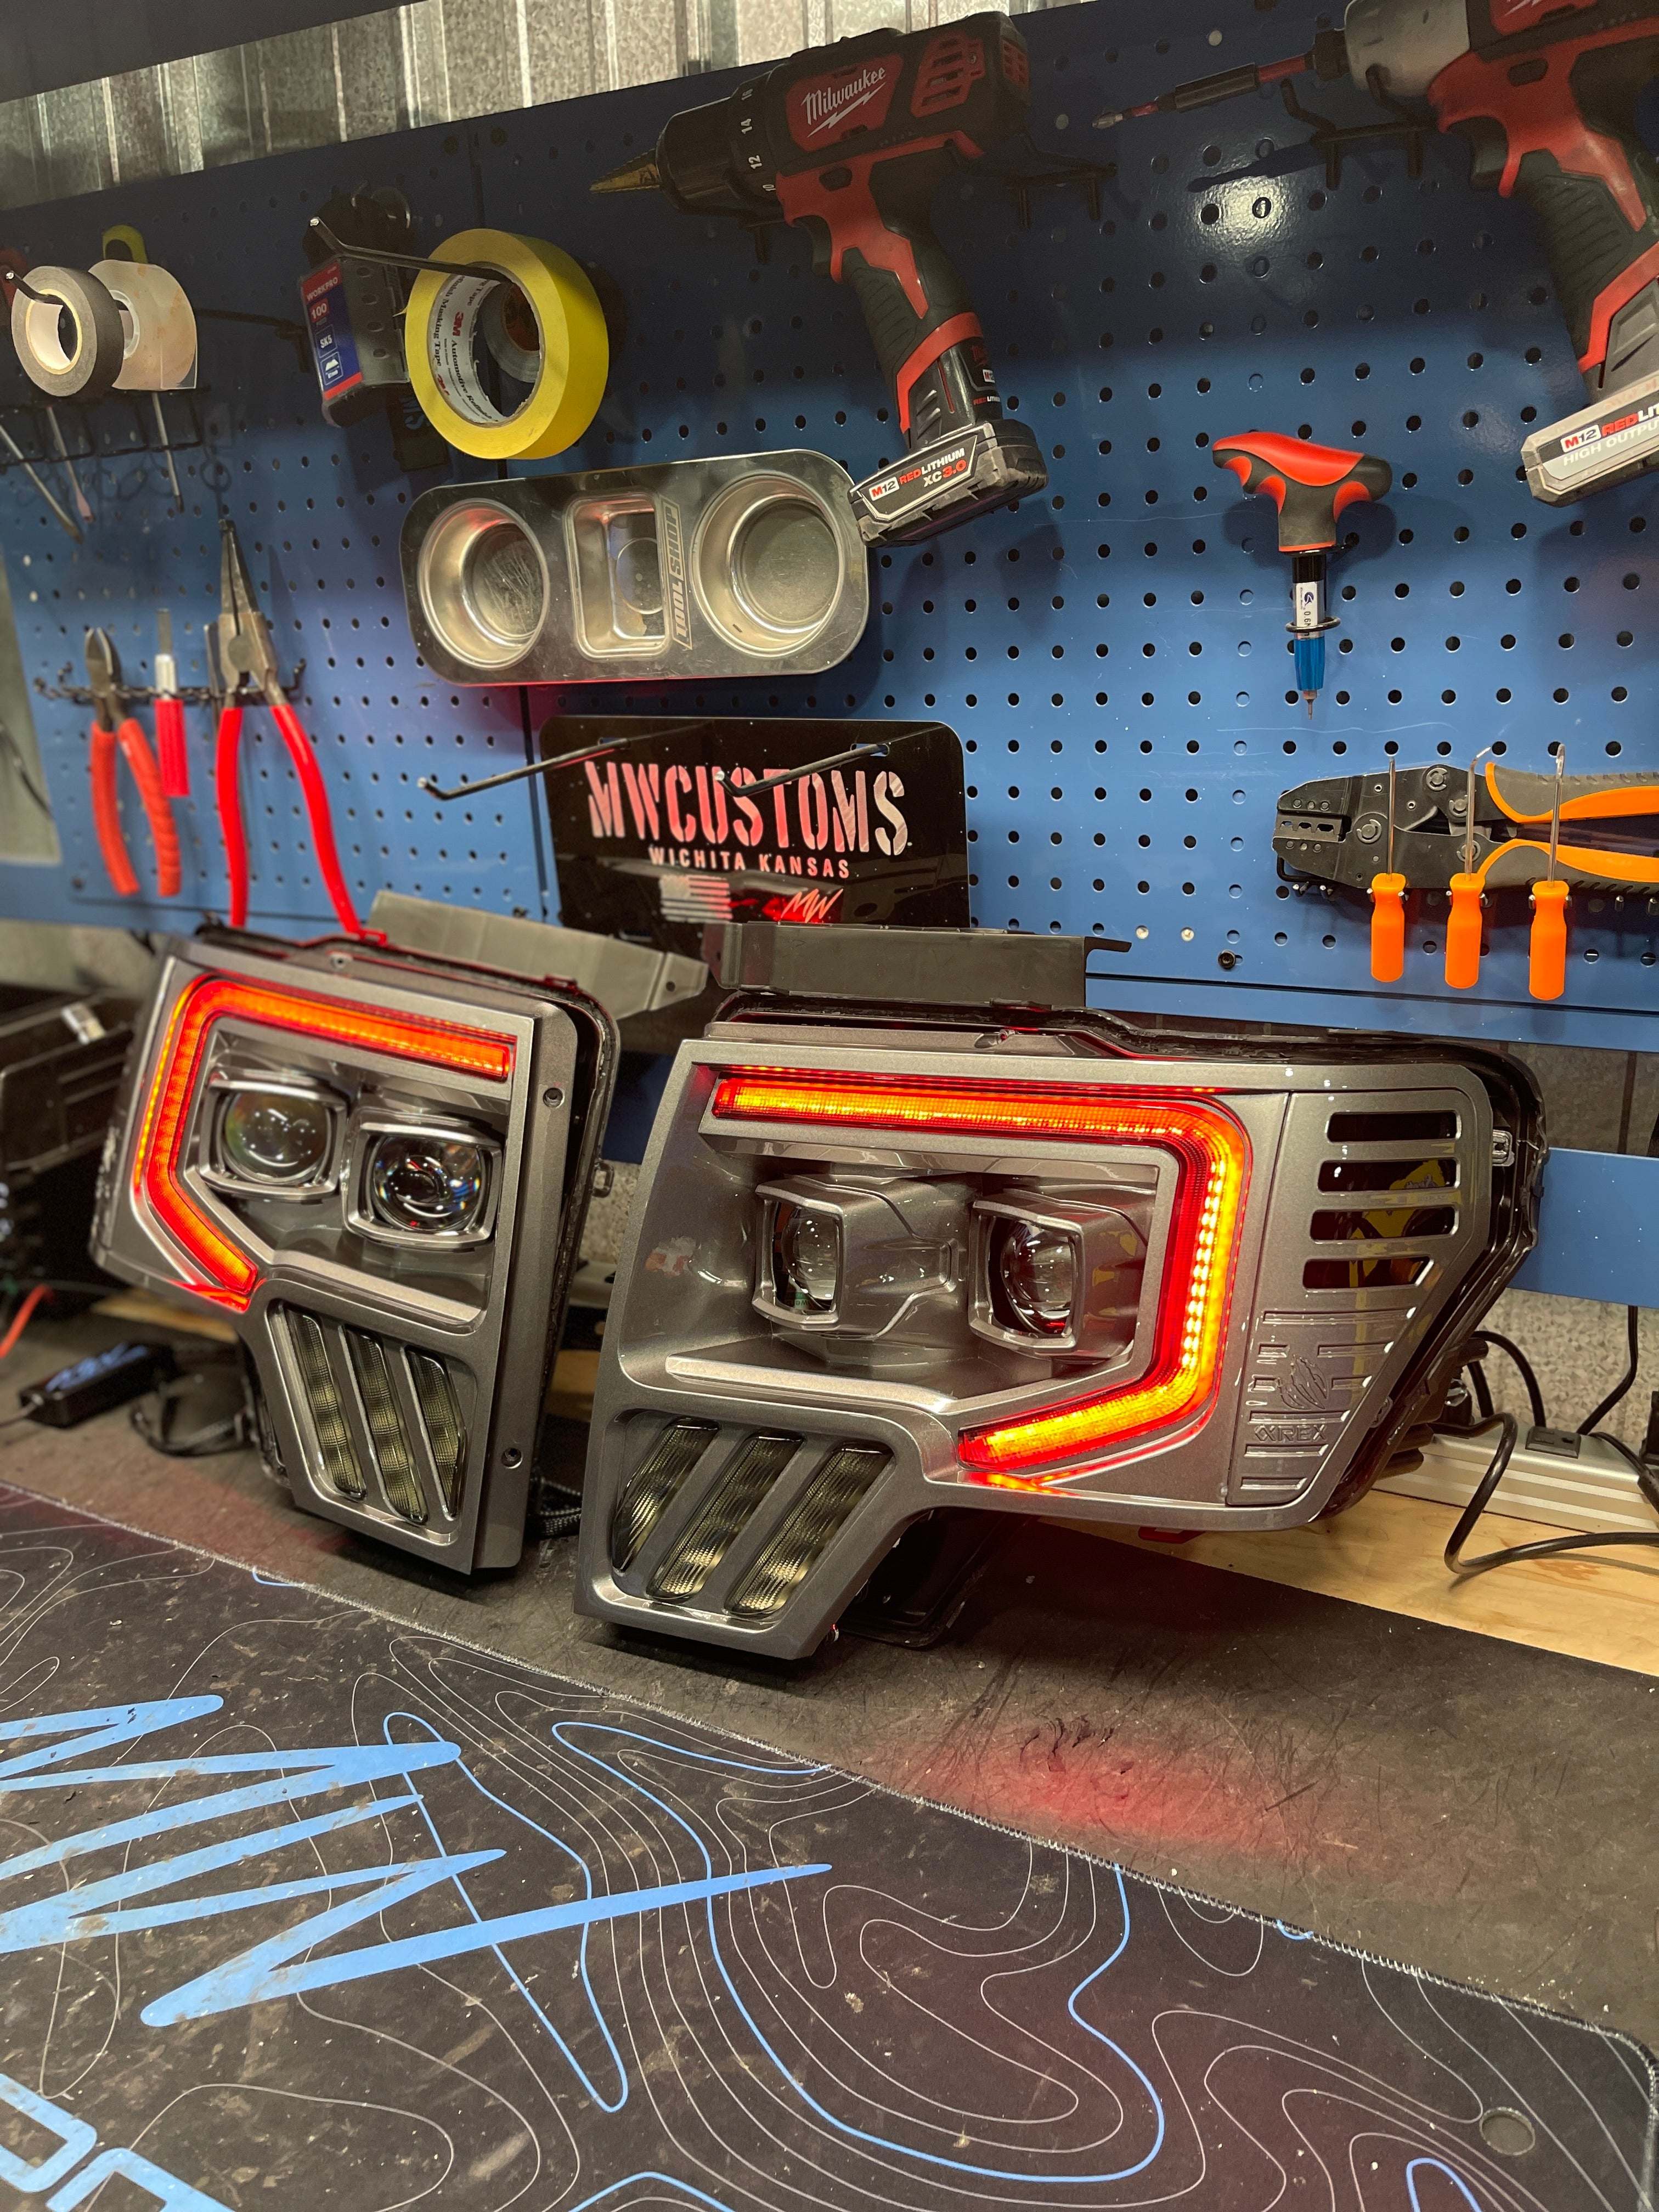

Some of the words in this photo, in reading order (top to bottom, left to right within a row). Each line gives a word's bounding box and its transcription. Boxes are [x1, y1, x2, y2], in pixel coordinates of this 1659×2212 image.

[801, 66, 887, 125] Milwaukee
[740, 118, 753, 135] 14
[748, 155, 763, 170] 12
[761, 183, 776, 193] 10
[307, 276, 338, 302] WORKPRO
[311, 303, 328, 319] 100
[433, 298, 449, 340] Masking
[452, 311, 464, 336] 3M
[320, 335, 332, 349] SK5
[433, 340, 442, 367] Tape
[451, 339, 469, 394] Automotive
[1564, 428, 1597, 449] M12
[1563, 443, 1601, 466] HIGH
[871, 481, 896, 498] M12
[665, 506, 681, 575] SHOP
[672, 580, 687, 637] TOOL
[584, 760, 909, 856] MWCUSTOMS
[648, 847, 746, 871] WICHITA
[759, 853, 850, 879] KANSAS
